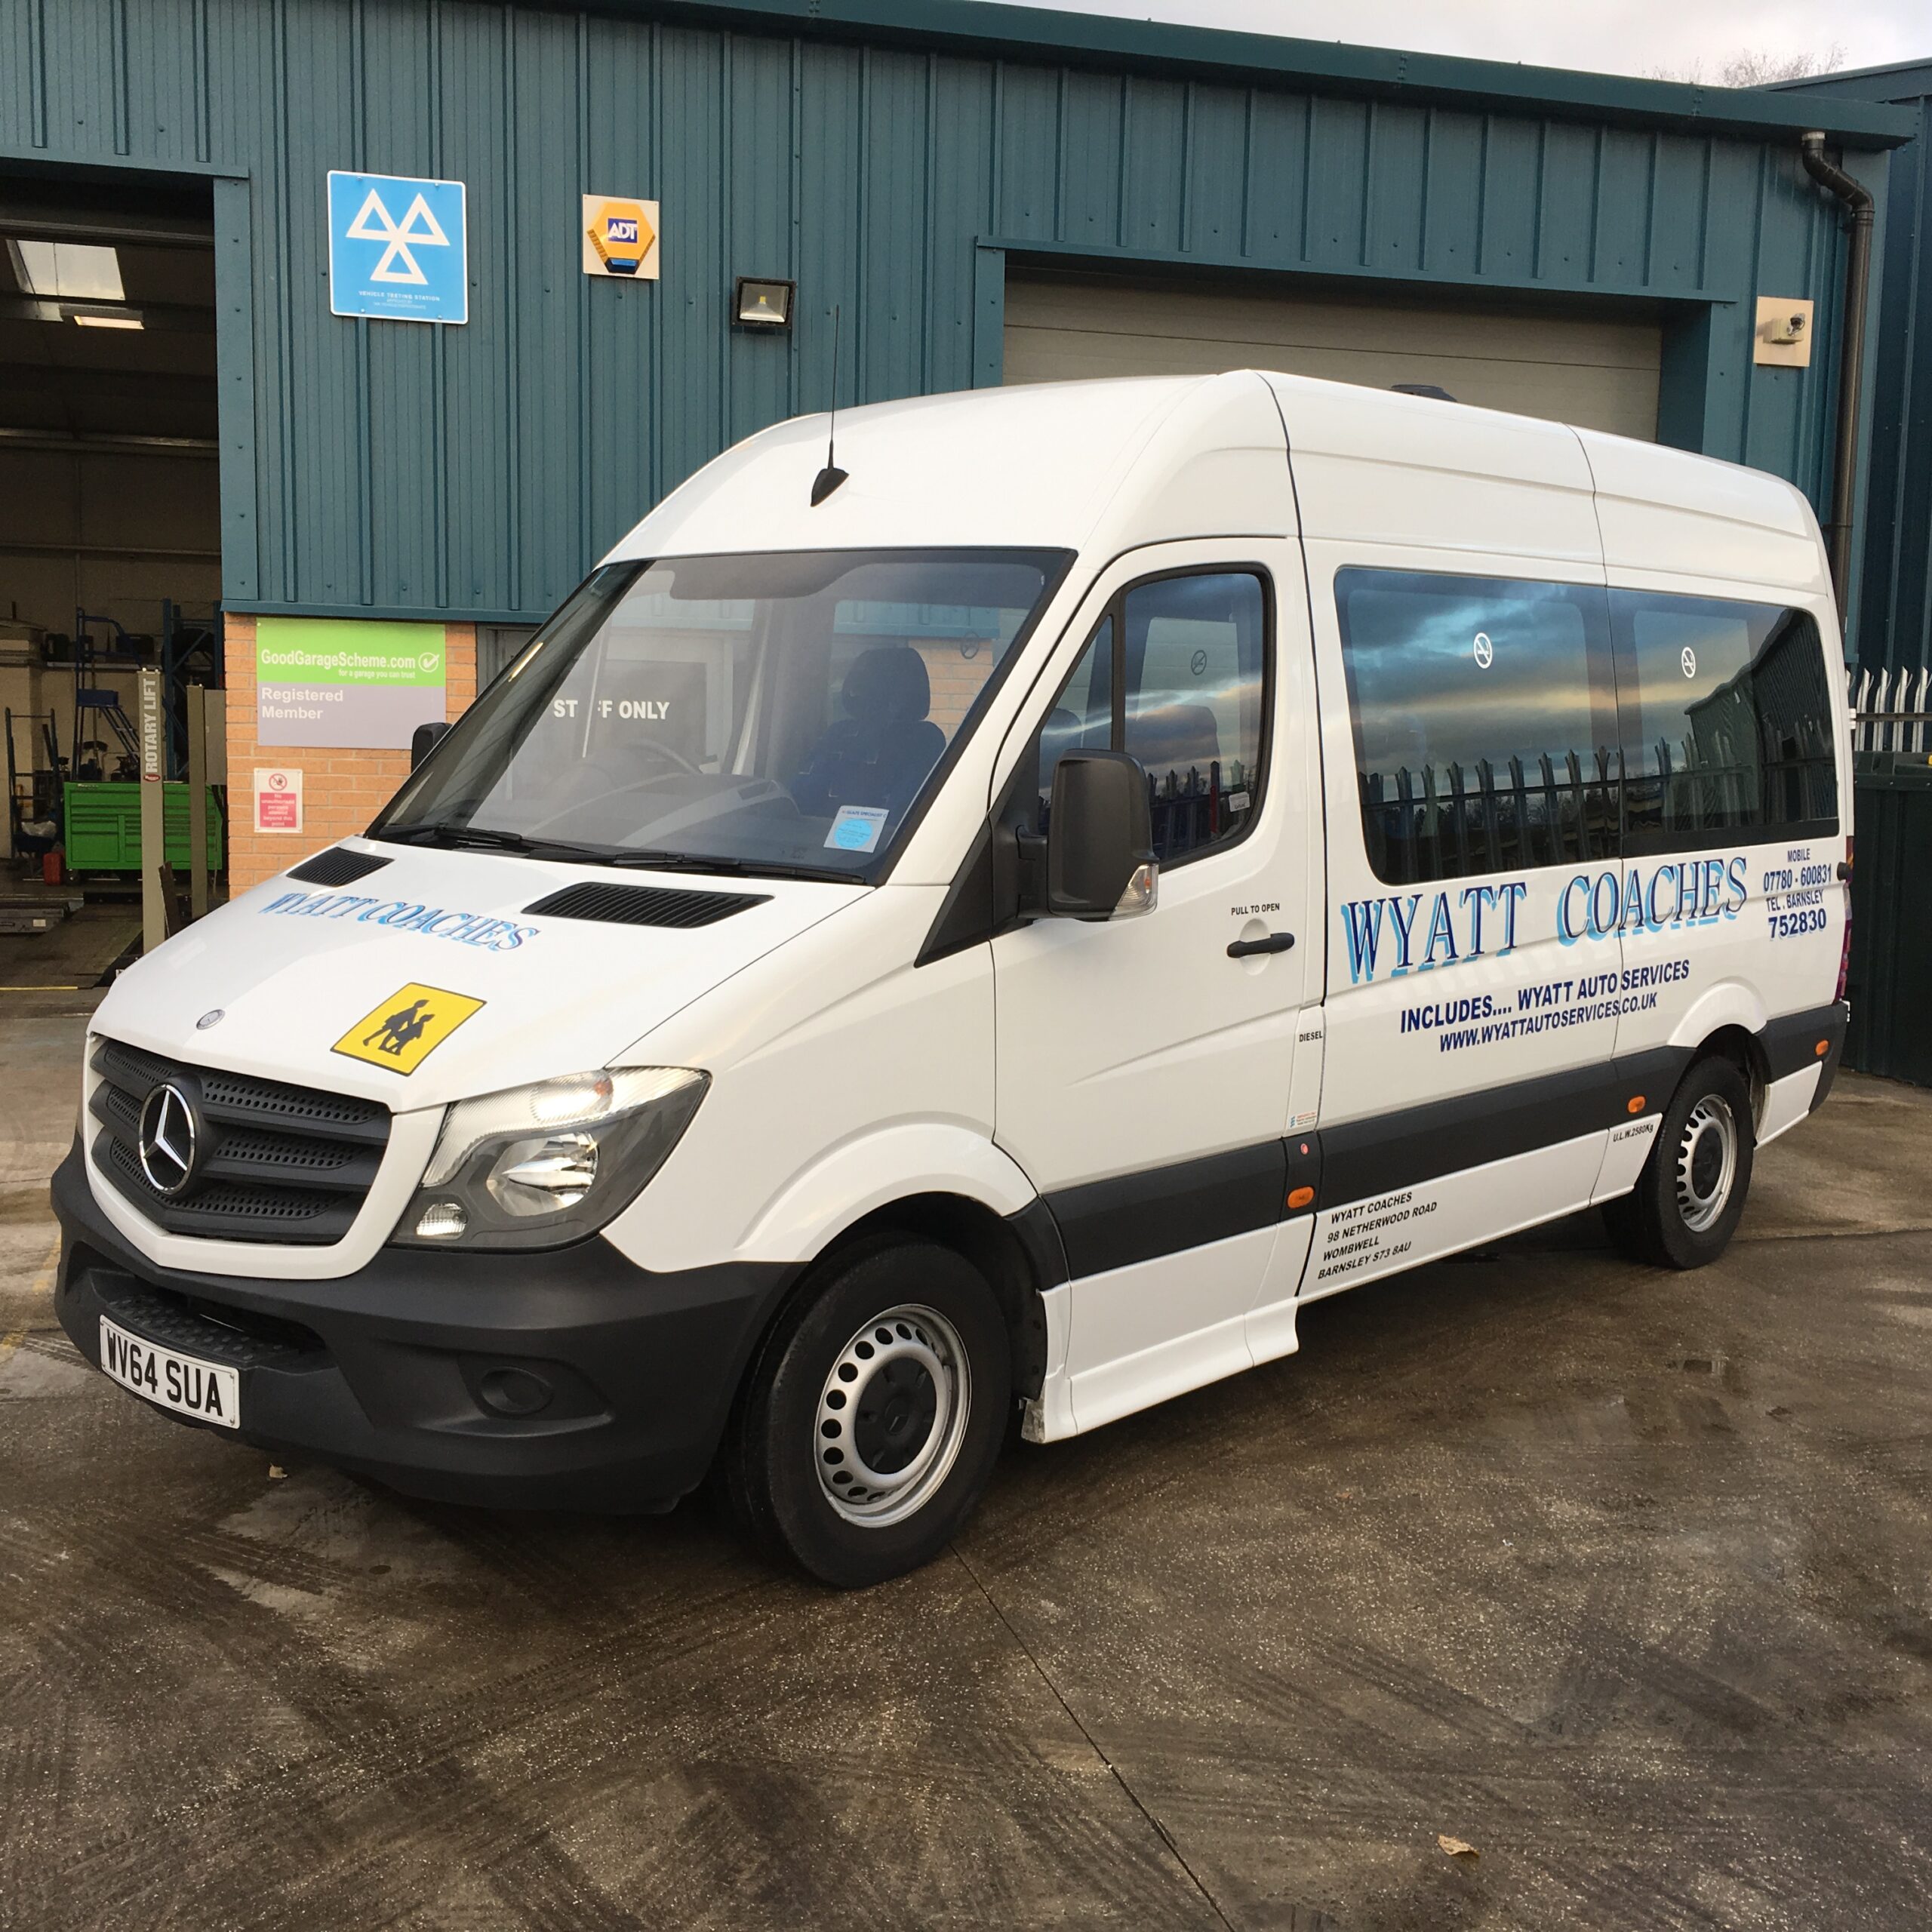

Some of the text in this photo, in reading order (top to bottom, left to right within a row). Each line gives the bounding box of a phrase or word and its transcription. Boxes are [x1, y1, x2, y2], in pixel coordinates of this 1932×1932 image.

[608, 222, 638, 240] ADT
[261, 649, 416, 670] GoodGarageScheme.com
[401, 670, 416, 678] trust
[143, 678, 157, 710] LIFT
[261, 688, 343, 703] Registered
[262, 706, 323, 719] Member
[619, 700, 670, 720] ONLY
[144, 713, 158, 773] ROTARY
[1787, 848, 1810, 862] MOBILE
[1764, 869, 1793, 892] 07780
[1801, 863, 1832, 886] 600831
[1231, 903, 1280, 915] PULL TO OPEN
[1786, 889, 1824, 909] BARNSLEY
[257, 893, 541, 951] WYATT COACHES
[1340, 857, 1748, 984] WYATT COACHES
[1768, 908, 1826, 939] 752830
[1518, 981, 1574, 1011] WYATT
[1577, 973, 1617, 1000] AUTO
[1620, 959, 1690, 991] SERVICES
[1299, 1030, 1323, 1042] DIESEL
[1440, 992, 1657, 1052] WWW.WYATTAUTOSERVICES.CO.UK
[1327, 1201, 1437, 1244] 98 NETHERWOOD ROAD
[1331, 1192, 1412, 1224] WYATT COACHES
[1318, 1241, 1412, 1279] BARNSLEY S73 8AU
[1323, 1236, 1380, 1262] WOMBWELL
[107, 1328, 223, 1417] WV64 SUA
